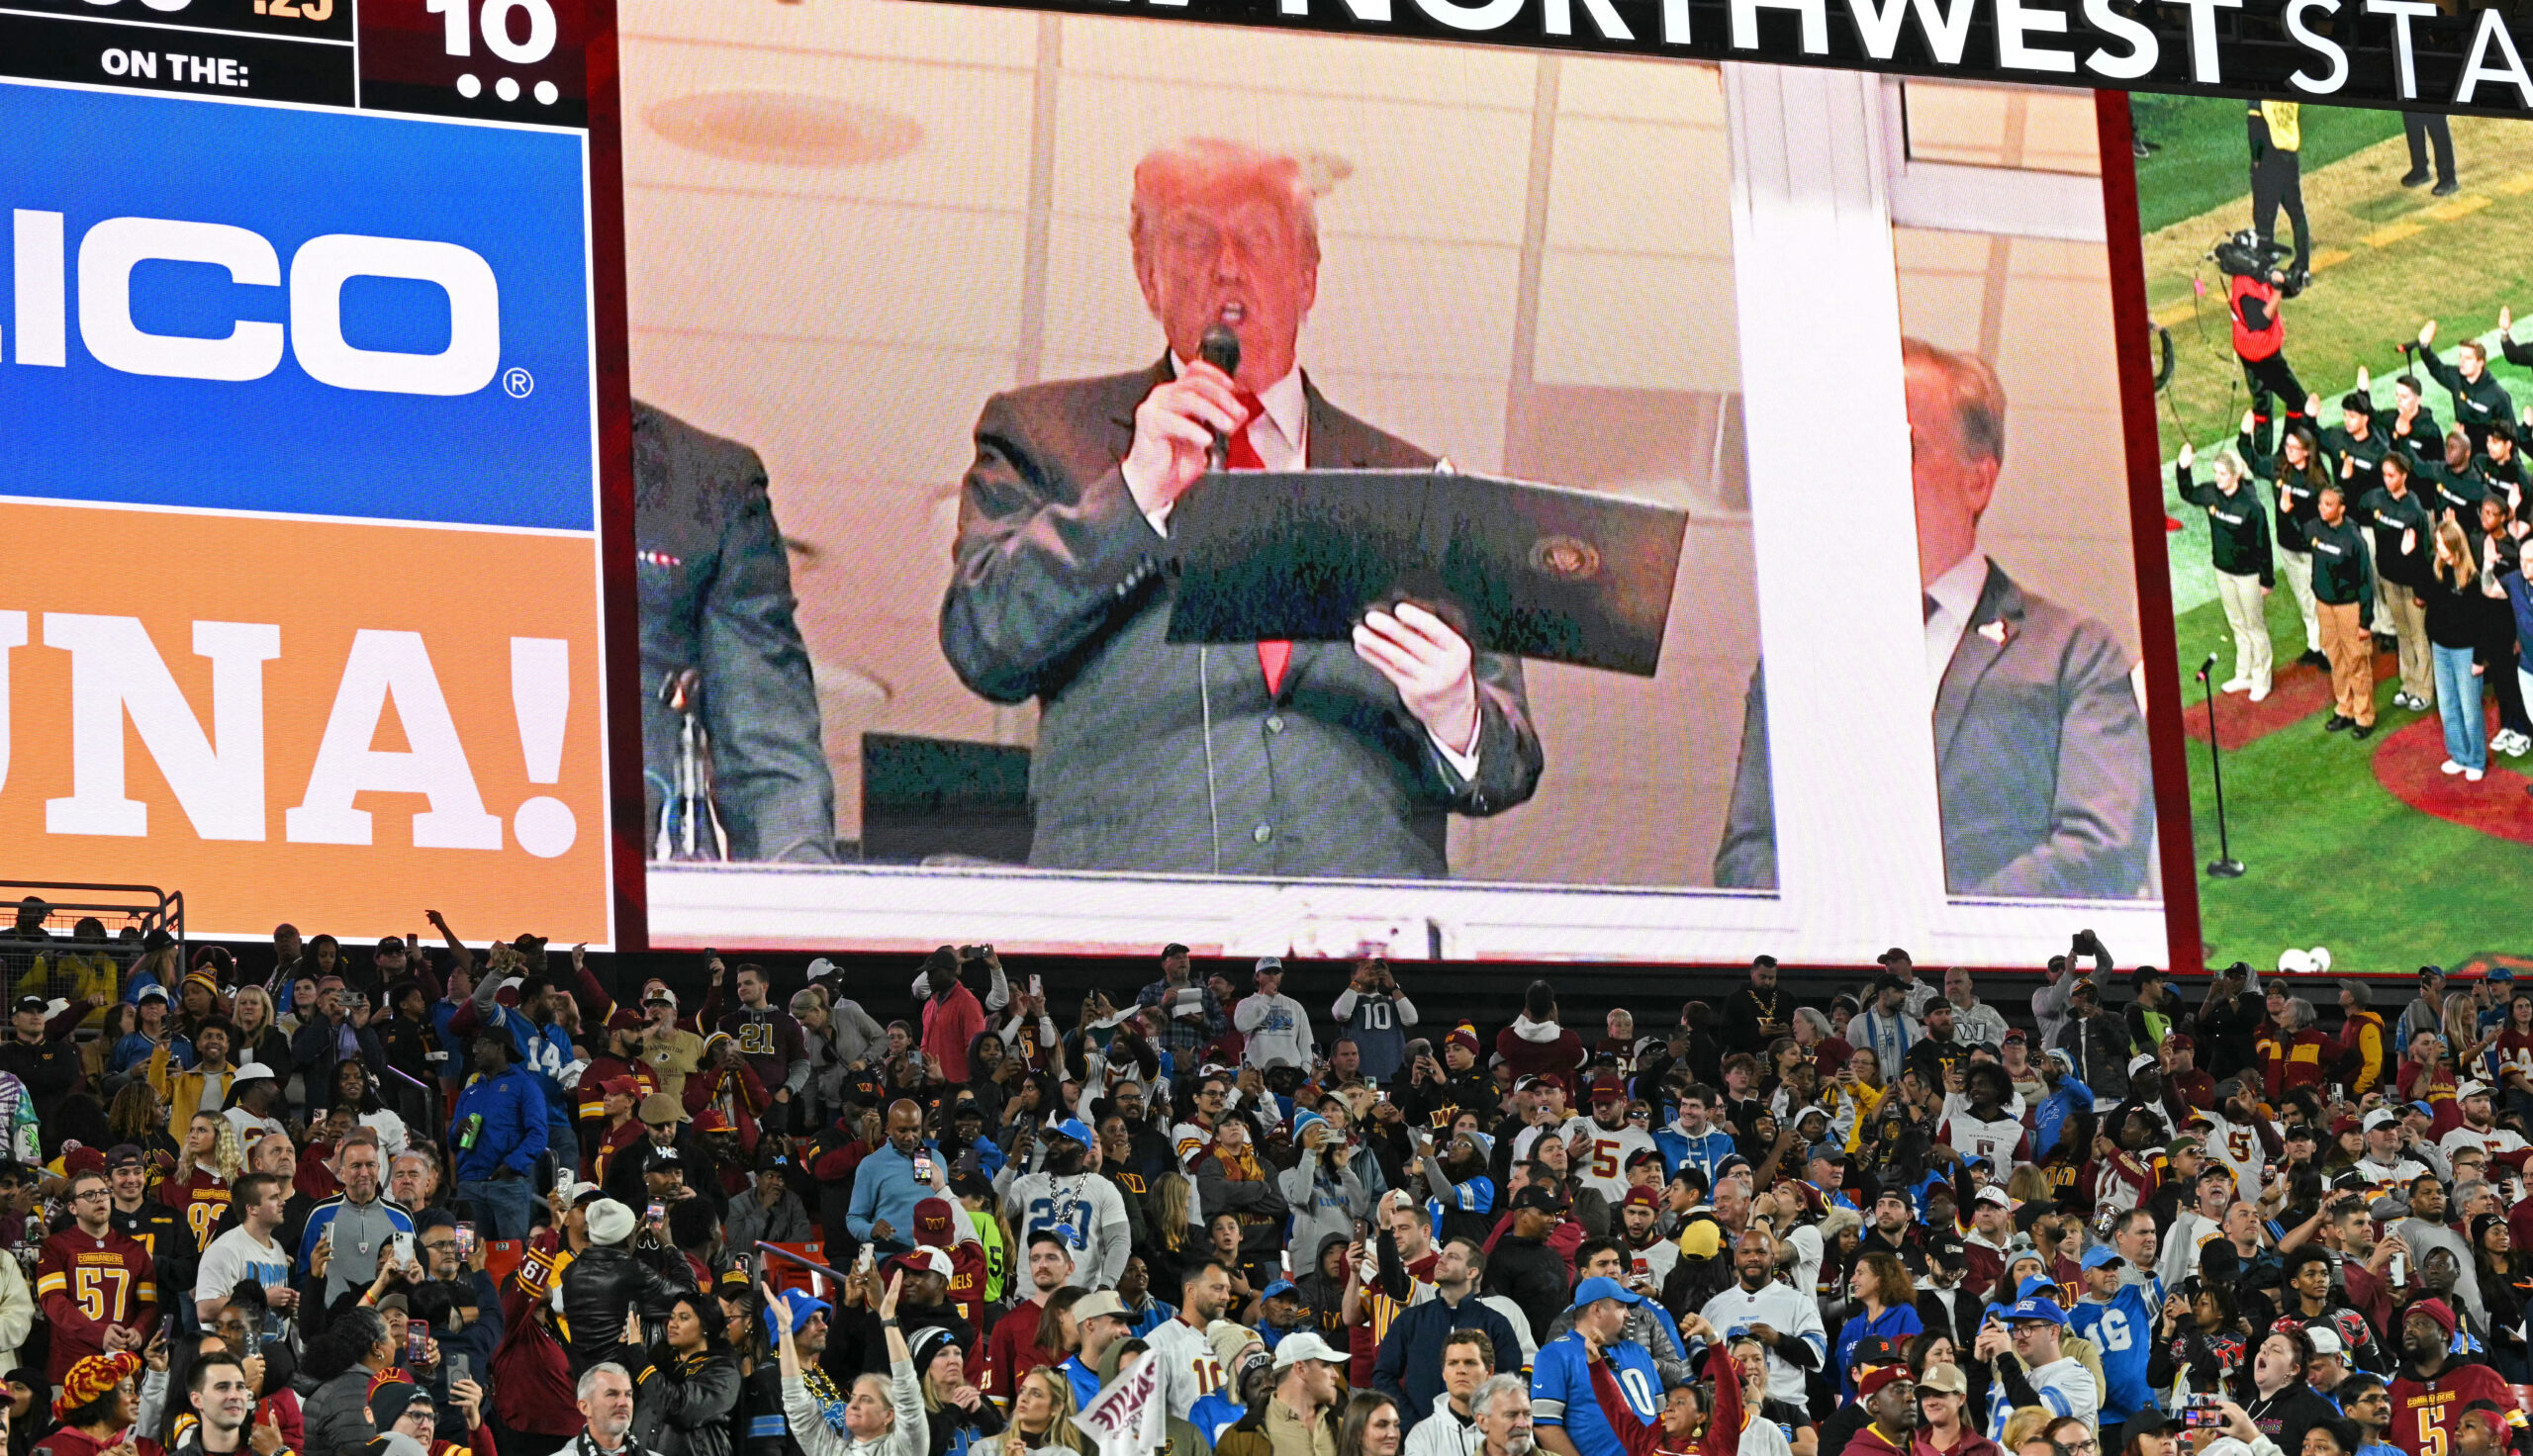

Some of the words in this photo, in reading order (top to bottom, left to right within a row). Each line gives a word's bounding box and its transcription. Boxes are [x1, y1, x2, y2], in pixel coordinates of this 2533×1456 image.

[425, 0, 556, 64] 10
[1276, 0, 2243, 84] HWEST
[101, 47, 156, 79] ON
[165, 53, 248, 88] THE:
[0, 208, 501, 396] ICO
[0, 610, 578, 859] NA!
[1362, 1003, 1391, 1030] 10
[527, 1037, 562, 1076] 14
[739, 1024, 775, 1054] 21
[1591, 1138, 1621, 1179] 5
[2229, 1131, 2250, 1163] 5
[192, 1188, 233, 1203] COMMANDER
[1029, 1197, 1093, 1252] 20
[77, 1252, 125, 1266] COMMANDERS
[497, 1242, 509, 1251] 22
[987, 1245, 1002, 1278] 5
[75, 1267, 131, 1322] 57
[1614, 1367, 1656, 1417] 0
[2417, 1405, 2449, 1456] 5
